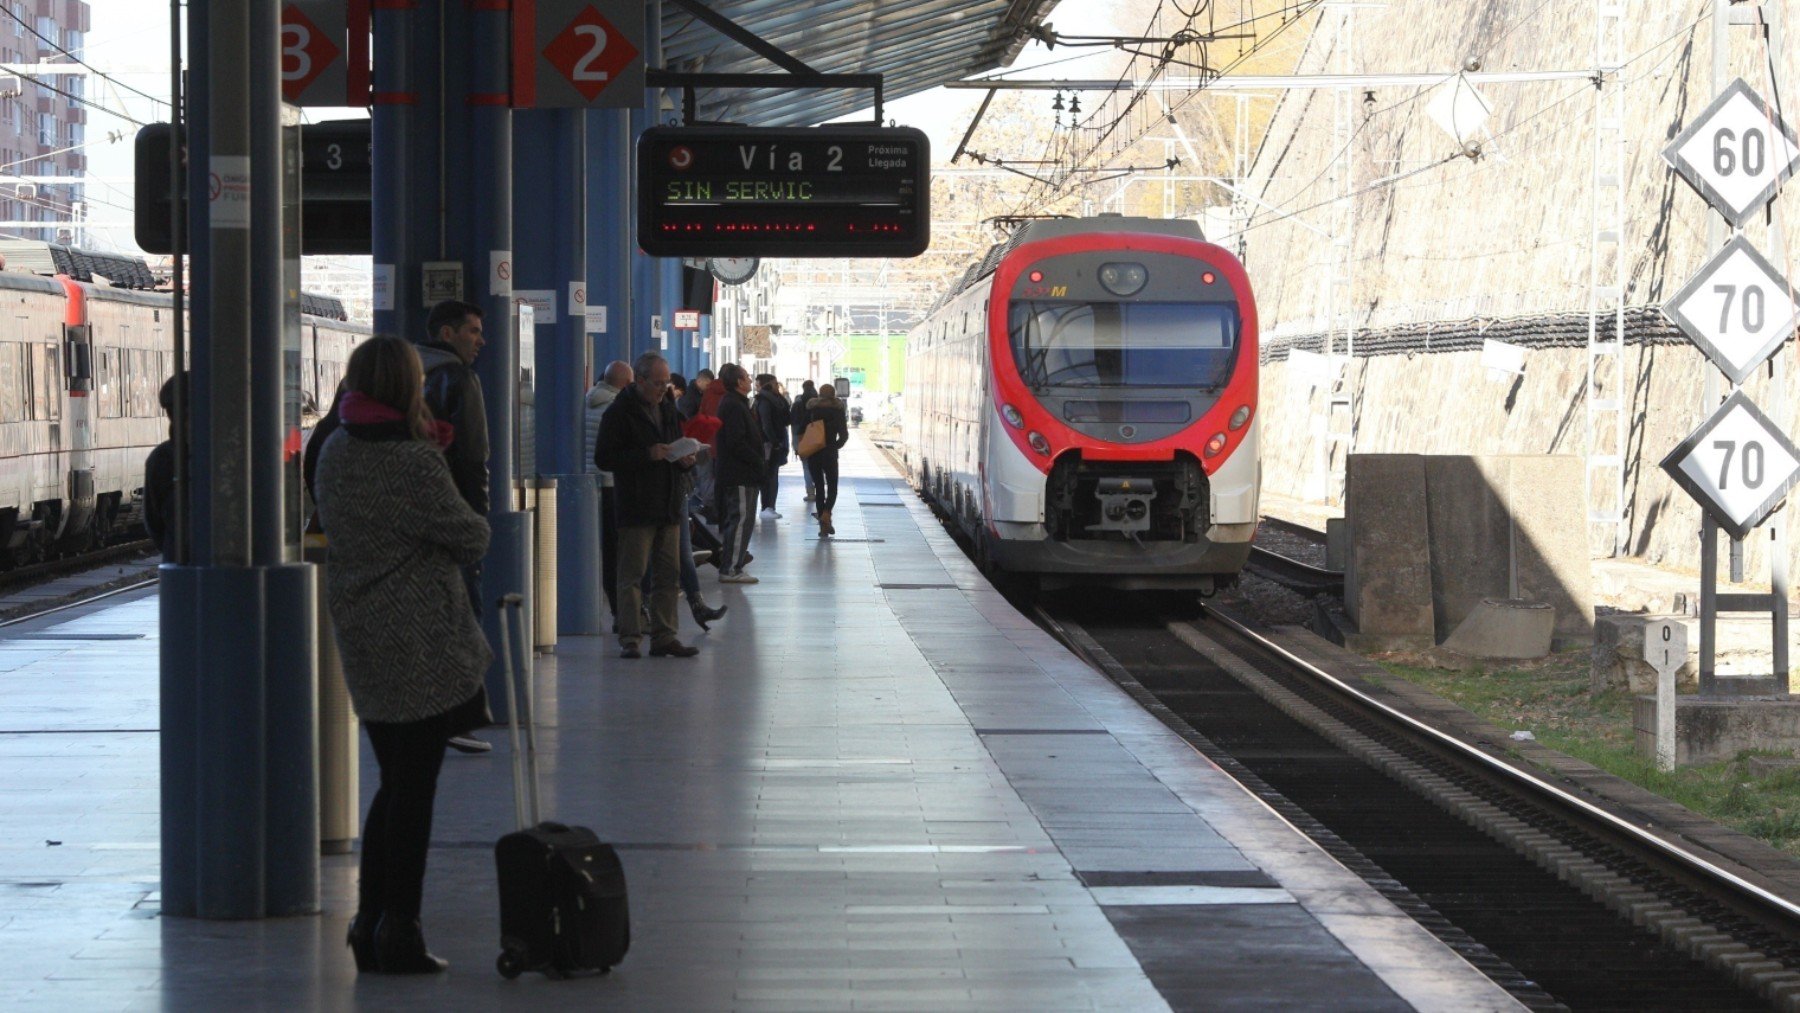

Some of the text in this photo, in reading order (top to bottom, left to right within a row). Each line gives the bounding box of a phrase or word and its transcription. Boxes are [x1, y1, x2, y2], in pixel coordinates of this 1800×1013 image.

[282, 24, 311, 82] 3
[572, 24, 609, 82] 2
[326, 142, 342, 171] 3
[739, 145, 844, 172] Vía 2
[868, 144, 908, 156] Próxima
[868, 157, 907, 169] Llegada
[1712, 127, 1765, 177] 60
[667, 181, 812, 200] SIN SERVIC
[1713, 284, 1765, 335] 70
[1713, 440, 1765, 491] 70
[1662, 625, 1671, 642] 0
